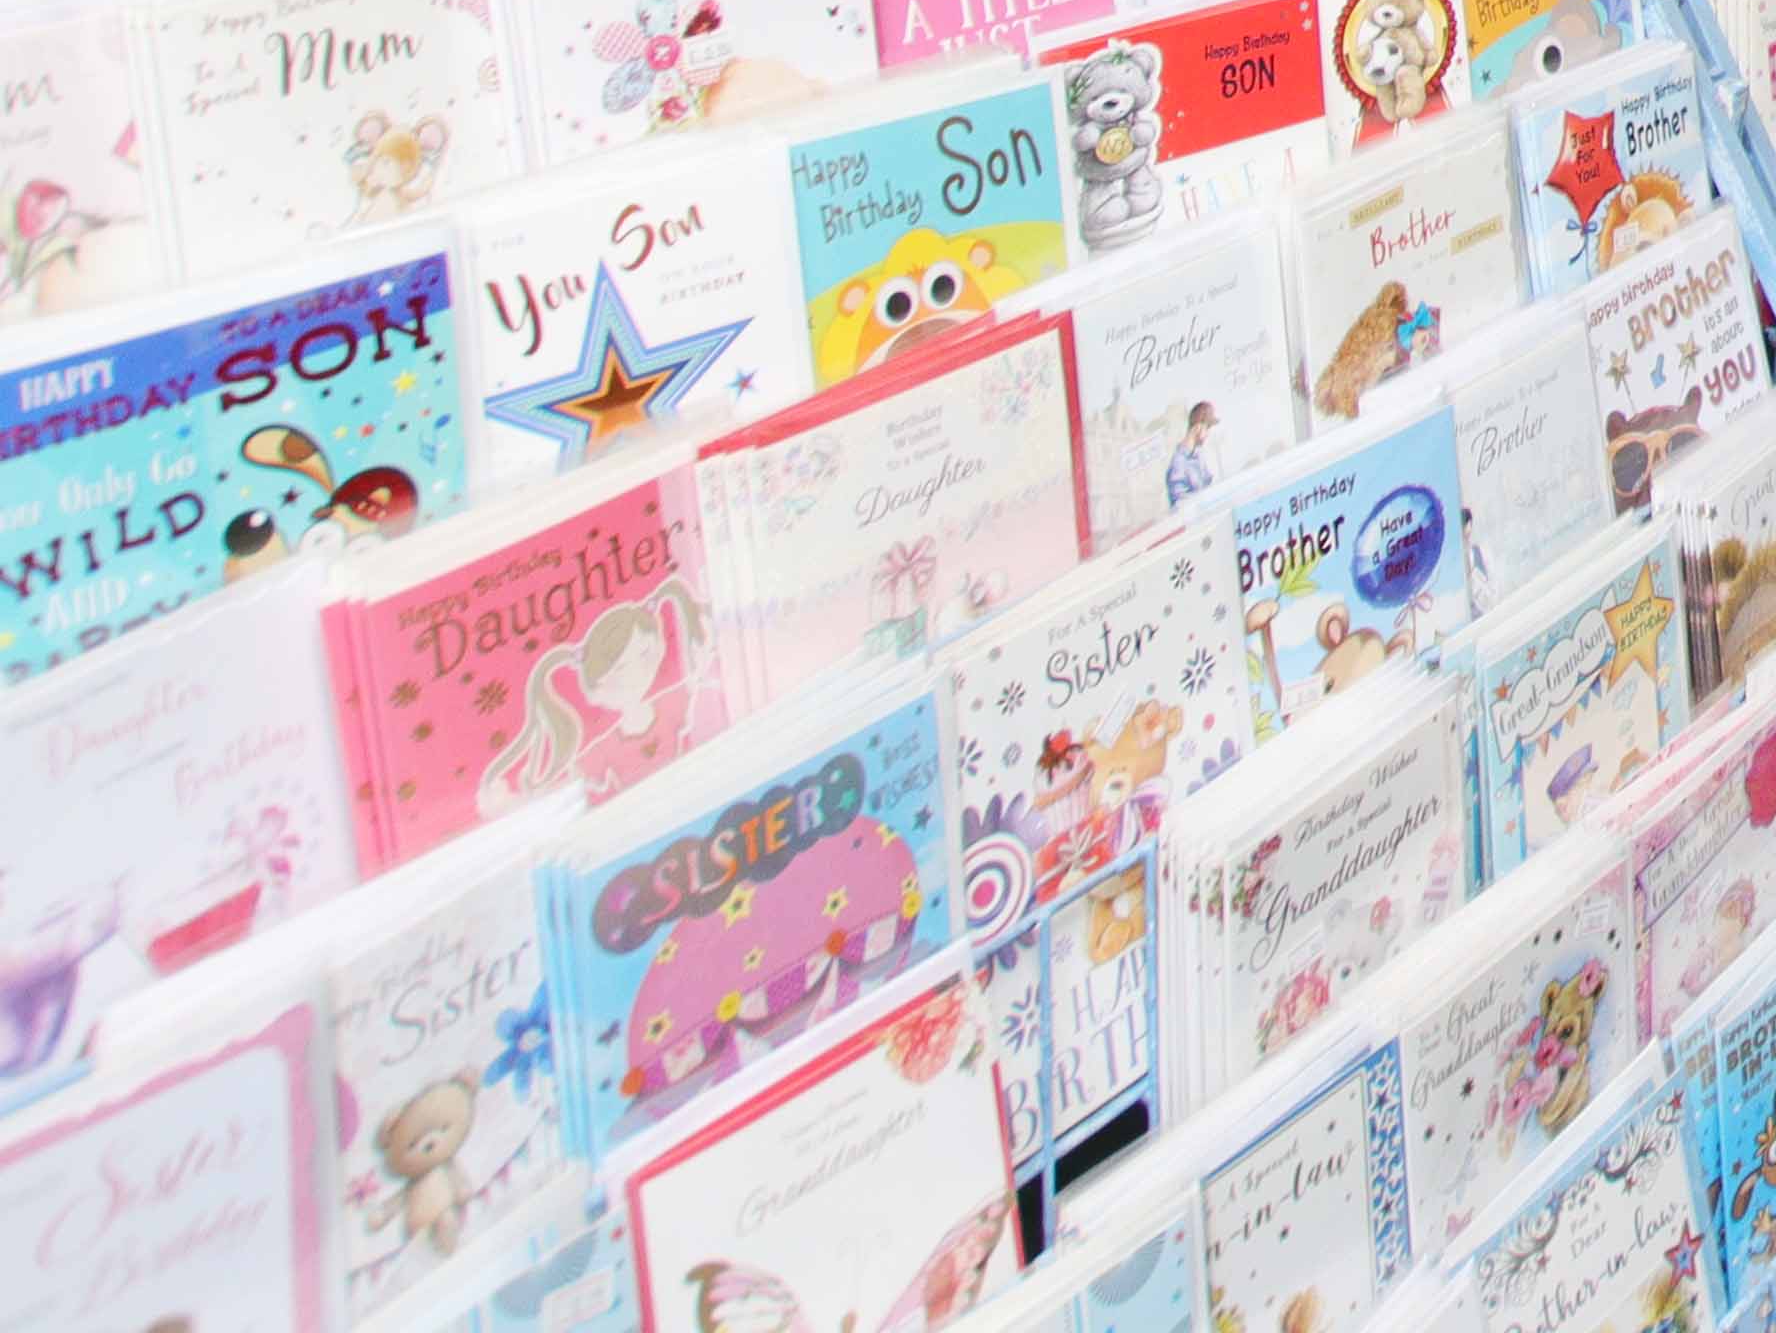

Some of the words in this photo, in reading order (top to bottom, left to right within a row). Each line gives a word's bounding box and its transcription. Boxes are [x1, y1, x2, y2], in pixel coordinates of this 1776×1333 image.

[902, 1, 934, 44] A
[1203, 41, 1239, 64] Happy
[1242, 27, 1291, 54] Birthday
[264, 26, 424, 97] Mum
[1220, 55, 1277, 102] SON
[791, 147, 870, 196] Happy
[936, 113, 1044, 217] Son
[1570, 127, 1598, 150] Just
[1626, 106, 1690, 158] Brother
[820, 185, 924, 245] Birthday
[1369, 210, 1457, 266] Brother
[486, 273, 588, 358] You
[609, 201, 708, 271] Son
[17, 355, 117, 415] HAPPY
[214, 291, 434, 415] SON
[1123, 322, 1222, 389] Brother
[855, 454, 988, 527] Daughter
[1380, 513, 1413, 536] Have
[1237, 515, 1346, 595] Brother
[417, 511, 692, 681] Daughter
[1044, 617, 1161, 711] Sister
[650, 784, 829, 916] SISTER
[1248, 793, 1444, 973] Granddaughter
[383, 941, 533, 1065] Sister
